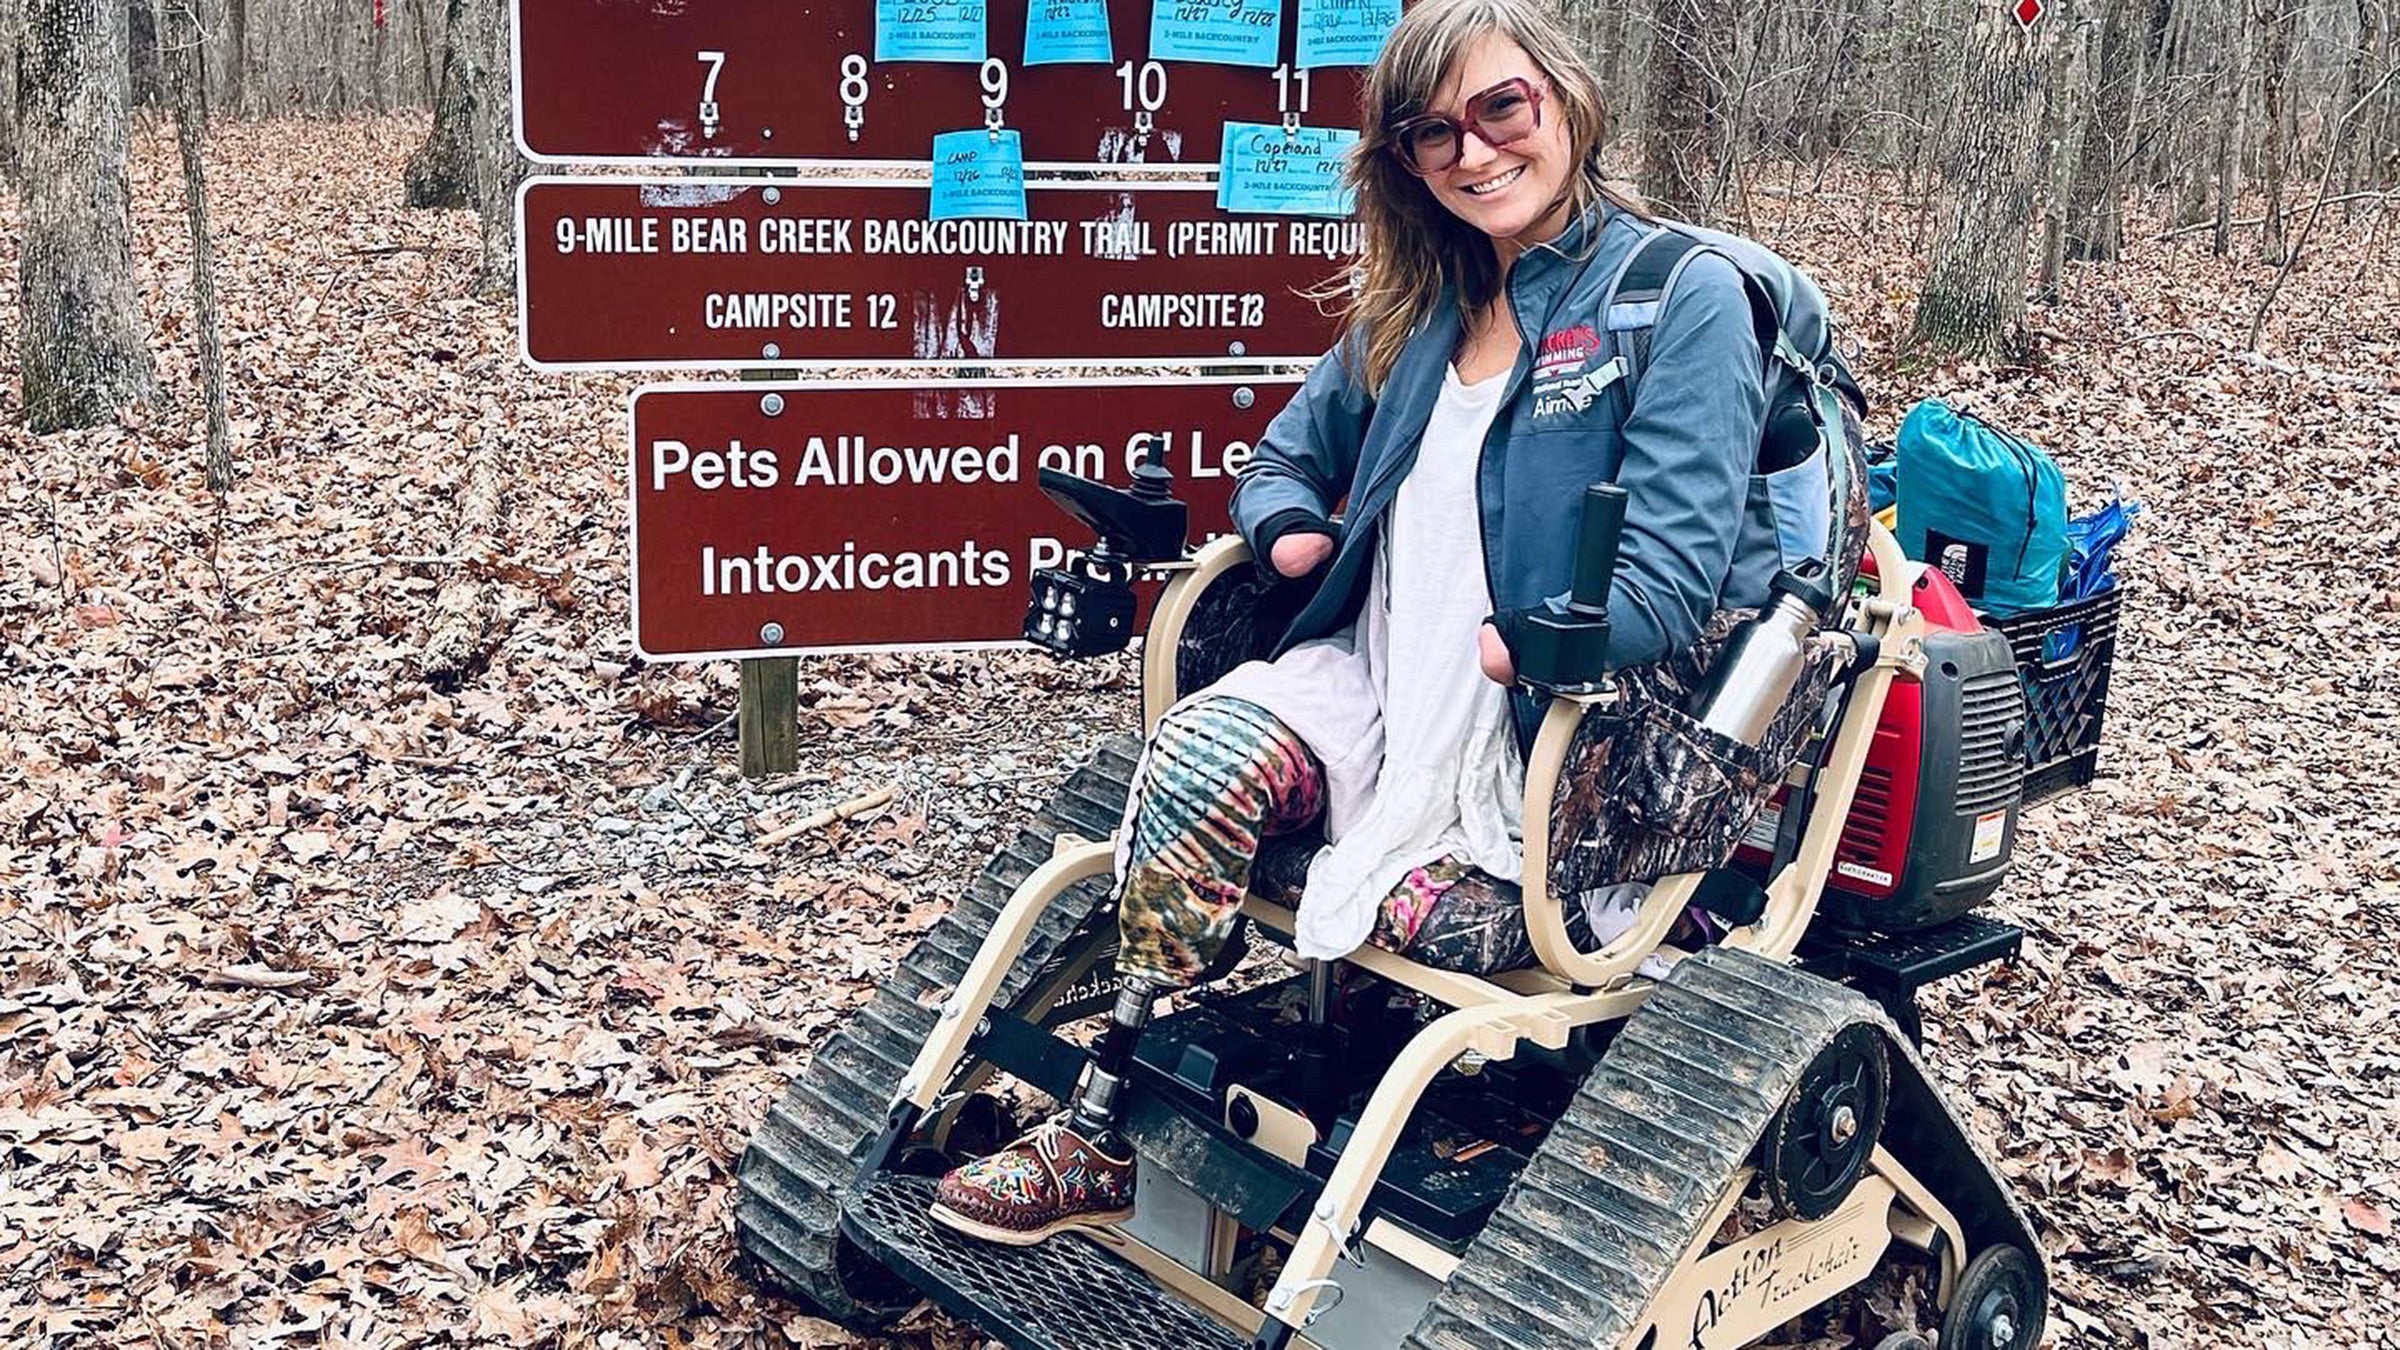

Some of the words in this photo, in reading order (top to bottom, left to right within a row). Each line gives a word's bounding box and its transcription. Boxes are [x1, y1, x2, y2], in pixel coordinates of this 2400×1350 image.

[698, 52, 725, 104] 7
[839, 55, 869, 105] 8
[980, 58, 1010, 107] 9
[1115, 61, 1167, 110] 10
[1271, 63, 1310, 112] 11
[557, 218, 658, 253] 9-MILE
[672, 219, 747, 253] BEAR
[760, 219, 852, 253] CREEK
[864, 219, 1068, 255] BACKCOUNTRY
[1080, 221, 1156, 255] TRAIL
[1168, 222, 1280, 259] (PERMIT
[705, 294, 851, 328] CAMPSITE
[866, 295, 898, 329] 12
[1102, 294, 1237, 328] CAMPSITE
[653, 440, 779, 491] Pets
[795, 435, 1018, 486] Allowed
[1038, 444, 1104, 481] on
[703, 541, 1010, 595] Intoxicants
[1688, 1237, 1783, 1350] Action
